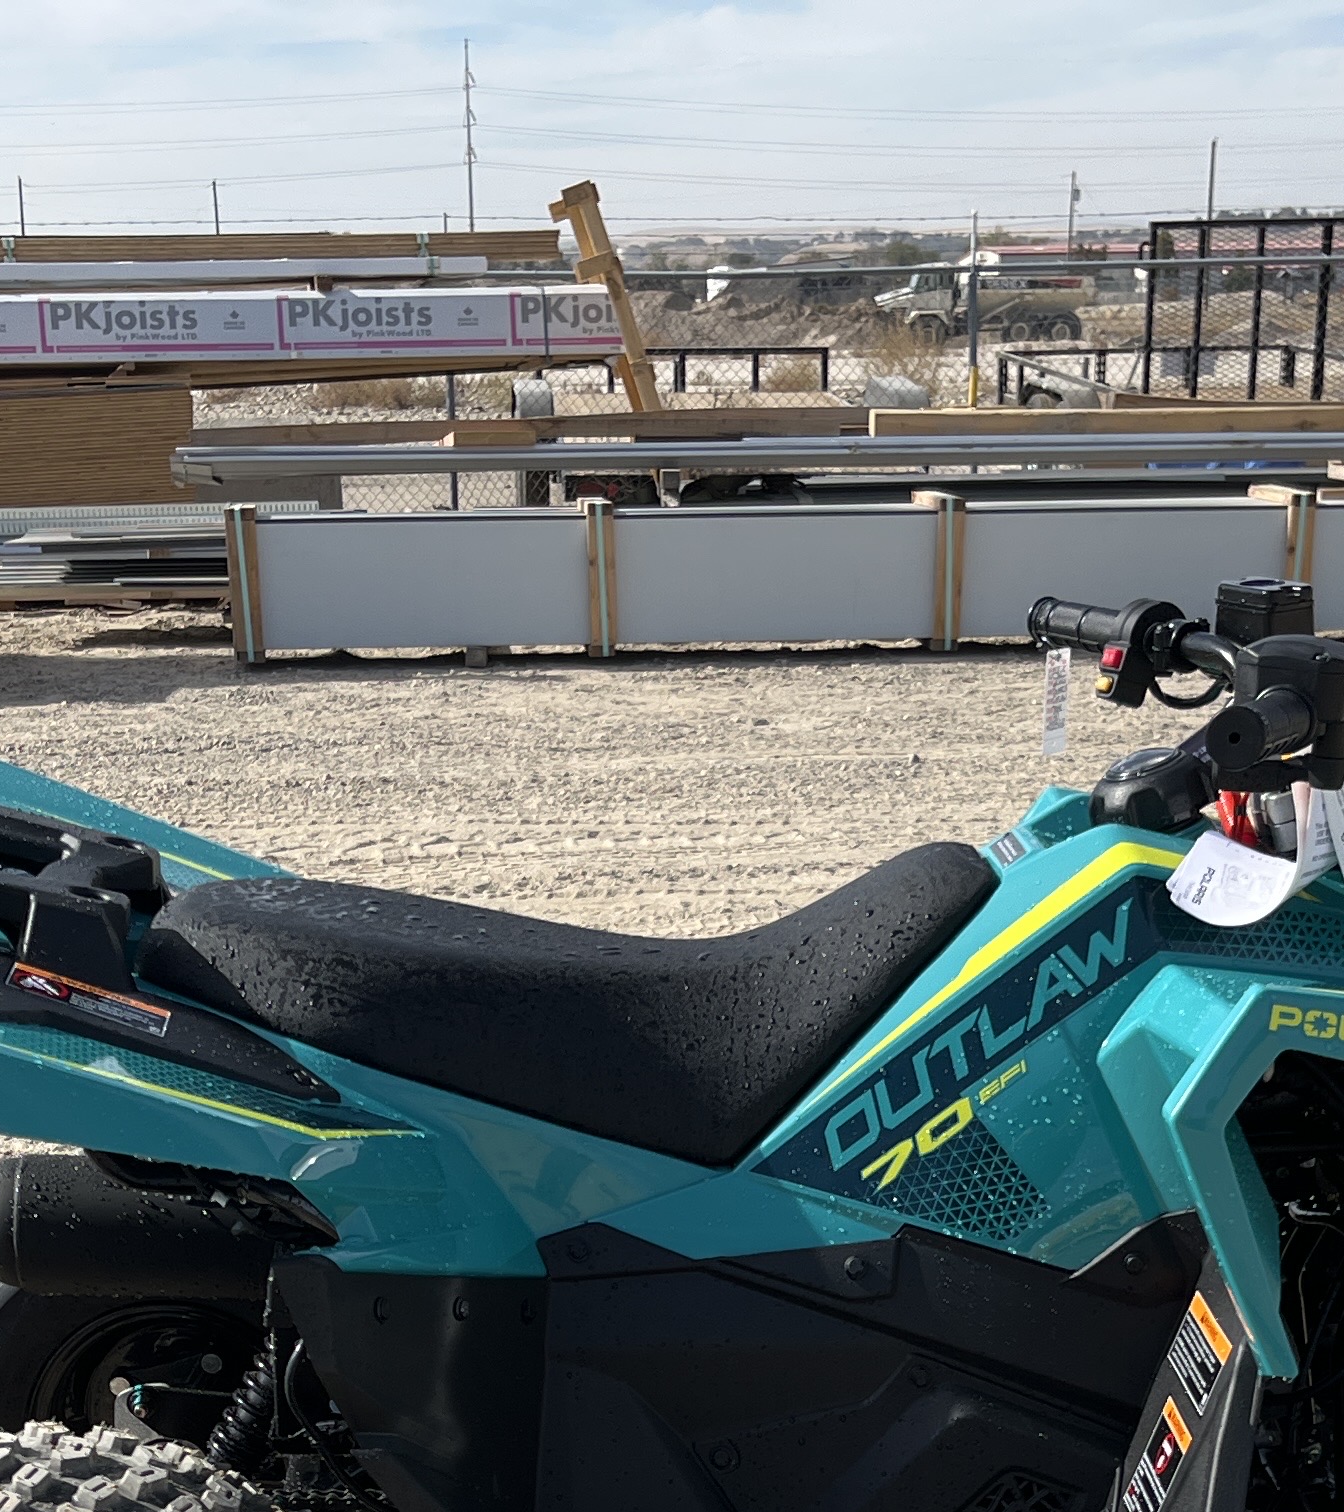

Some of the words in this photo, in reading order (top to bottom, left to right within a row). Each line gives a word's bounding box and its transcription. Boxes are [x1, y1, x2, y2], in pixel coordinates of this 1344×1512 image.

[49, 300, 198, 335] PKjoists
[287, 297, 433, 332] PKjoists
[520, 295, 613, 328] PKjoi
[115, 332, 128, 342] by
[351, 329, 364, 339] by
[1191, 866, 1216, 906] POLARIS
[824, 896, 1134, 1171] OUTLAW
[860, 1096, 974, 1196] 70
[977, 1058, 1028, 1106] EFI
